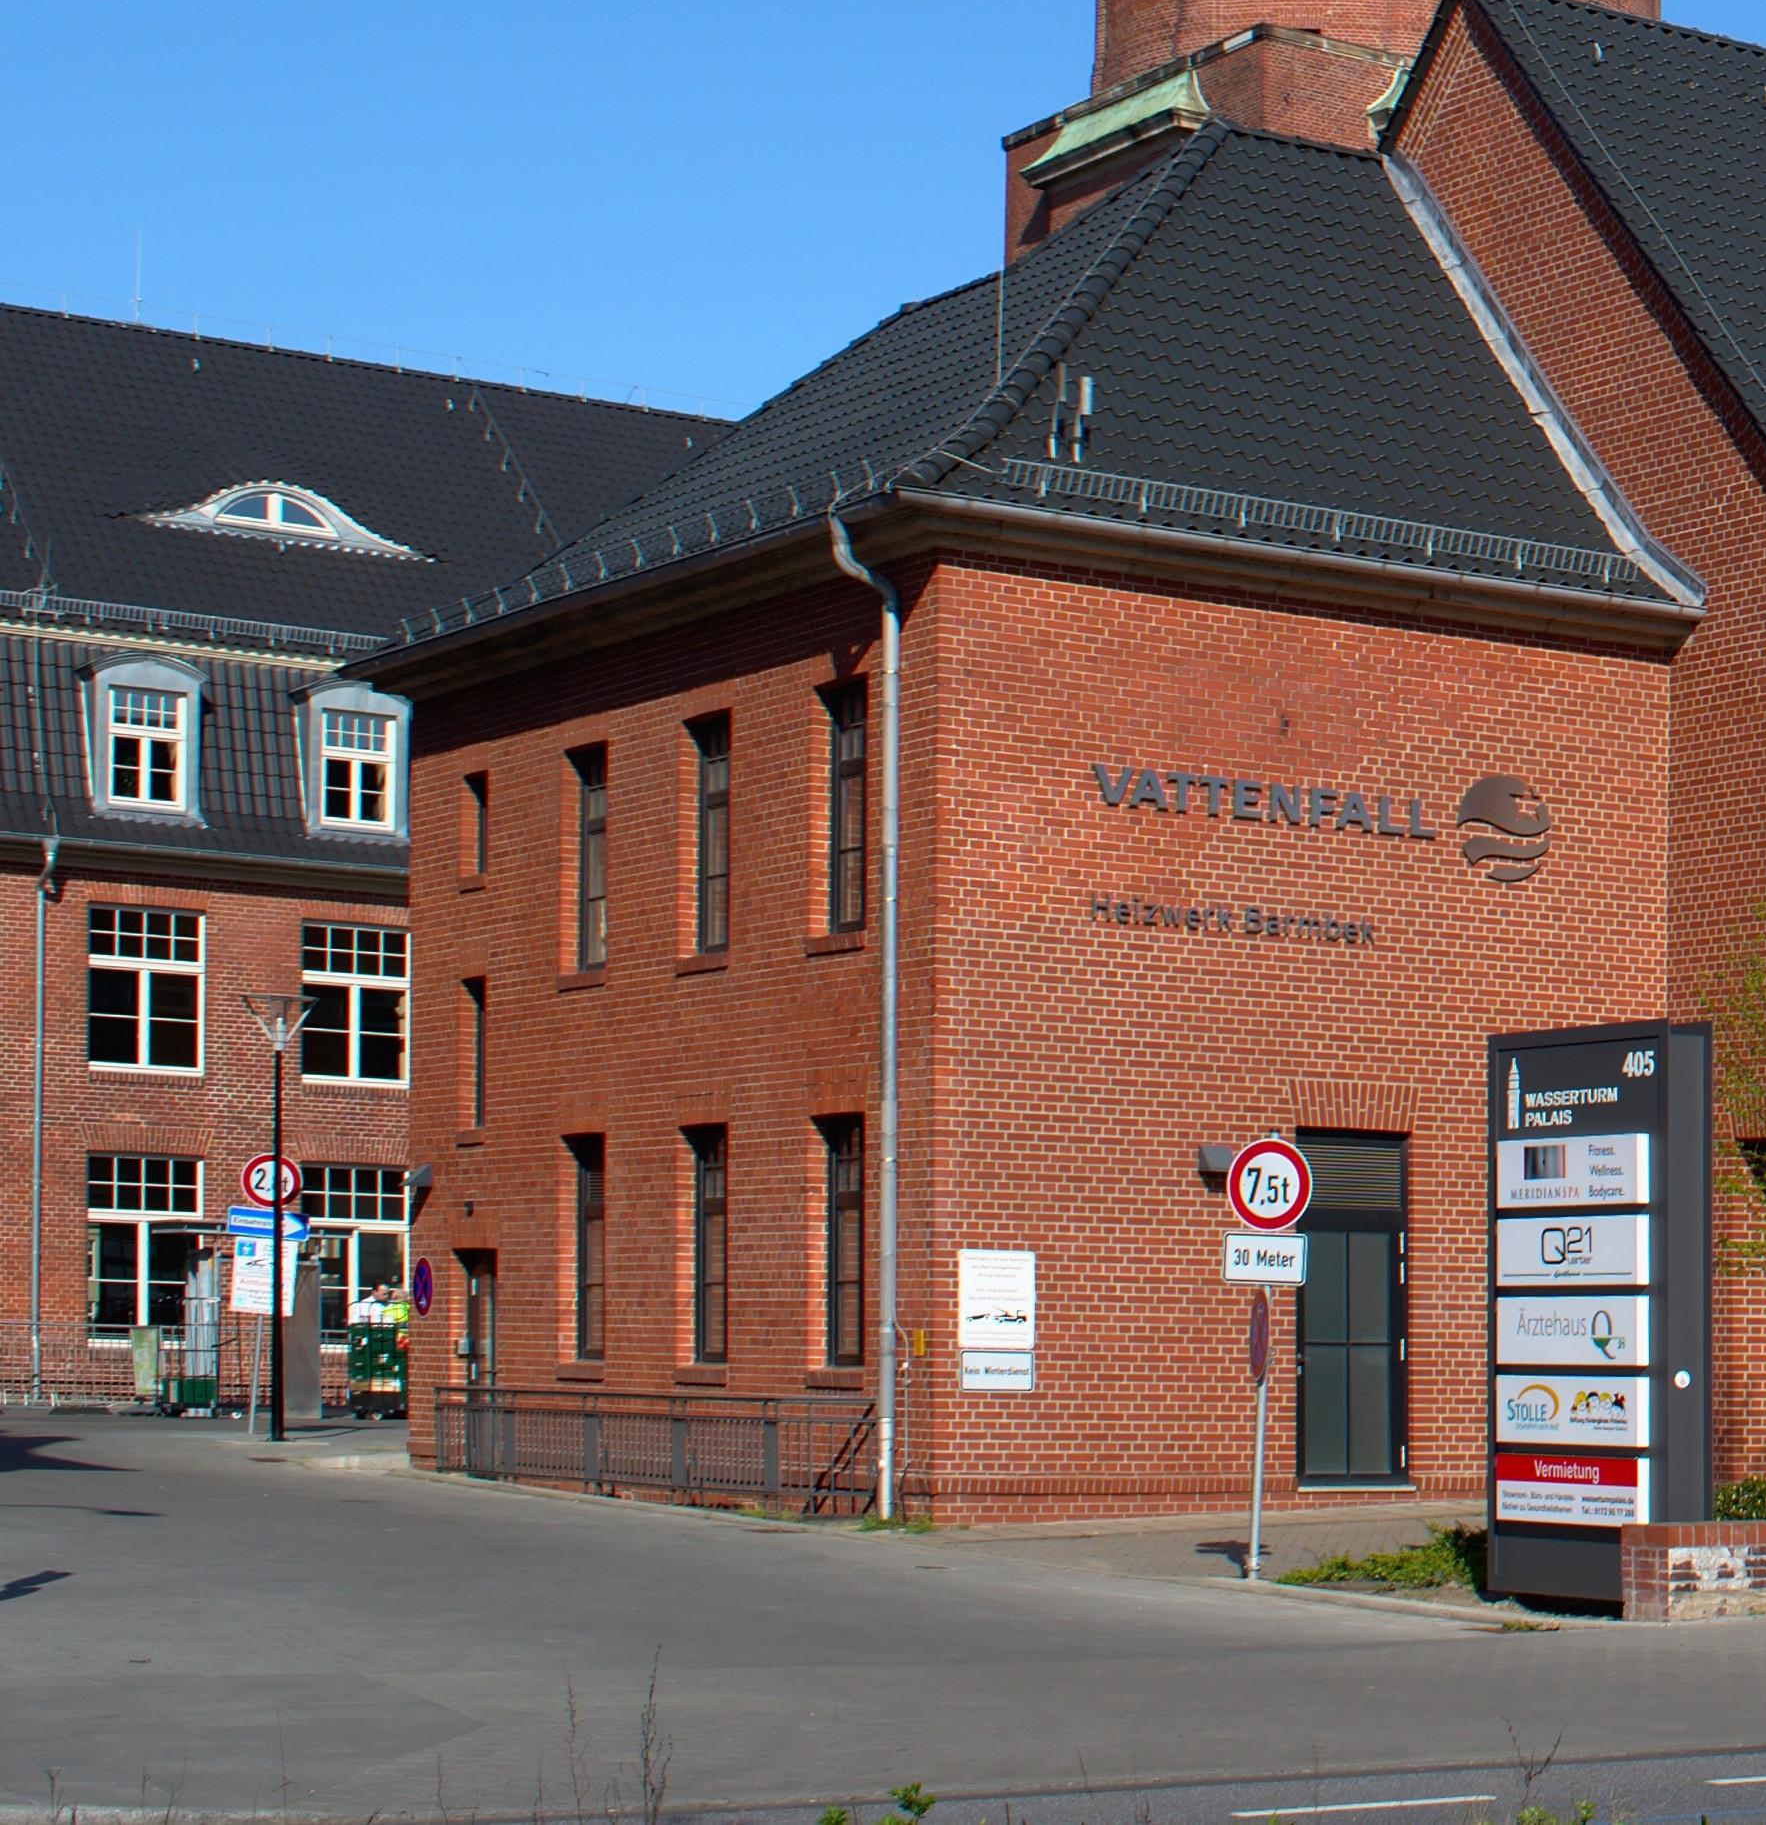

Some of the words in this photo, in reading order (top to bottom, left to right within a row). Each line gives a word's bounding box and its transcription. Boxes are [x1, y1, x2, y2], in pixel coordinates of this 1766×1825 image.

[1095, 763, 1436, 839] VATTENFALL
[1089, 891, 1231, 931] Heizwerk
[1244, 904, 1379, 946] Barmbek
[1621, 1051, 1655, 1078] 405
[1525, 1087, 1618, 1108] WASSERTURM
[1525, 1109, 1573, 1128] PALAIS
[254, 1167, 289, 1193] 2,t
[1247, 1166, 1290, 1206] 7,5t
[1234, 1247, 1250, 1266] 30
[1256, 1248, 1296, 1268] Meter
[1516, 1307, 1587, 1337] Ärztehaus
[1533, 1459, 1600, 1484] Vermietung
